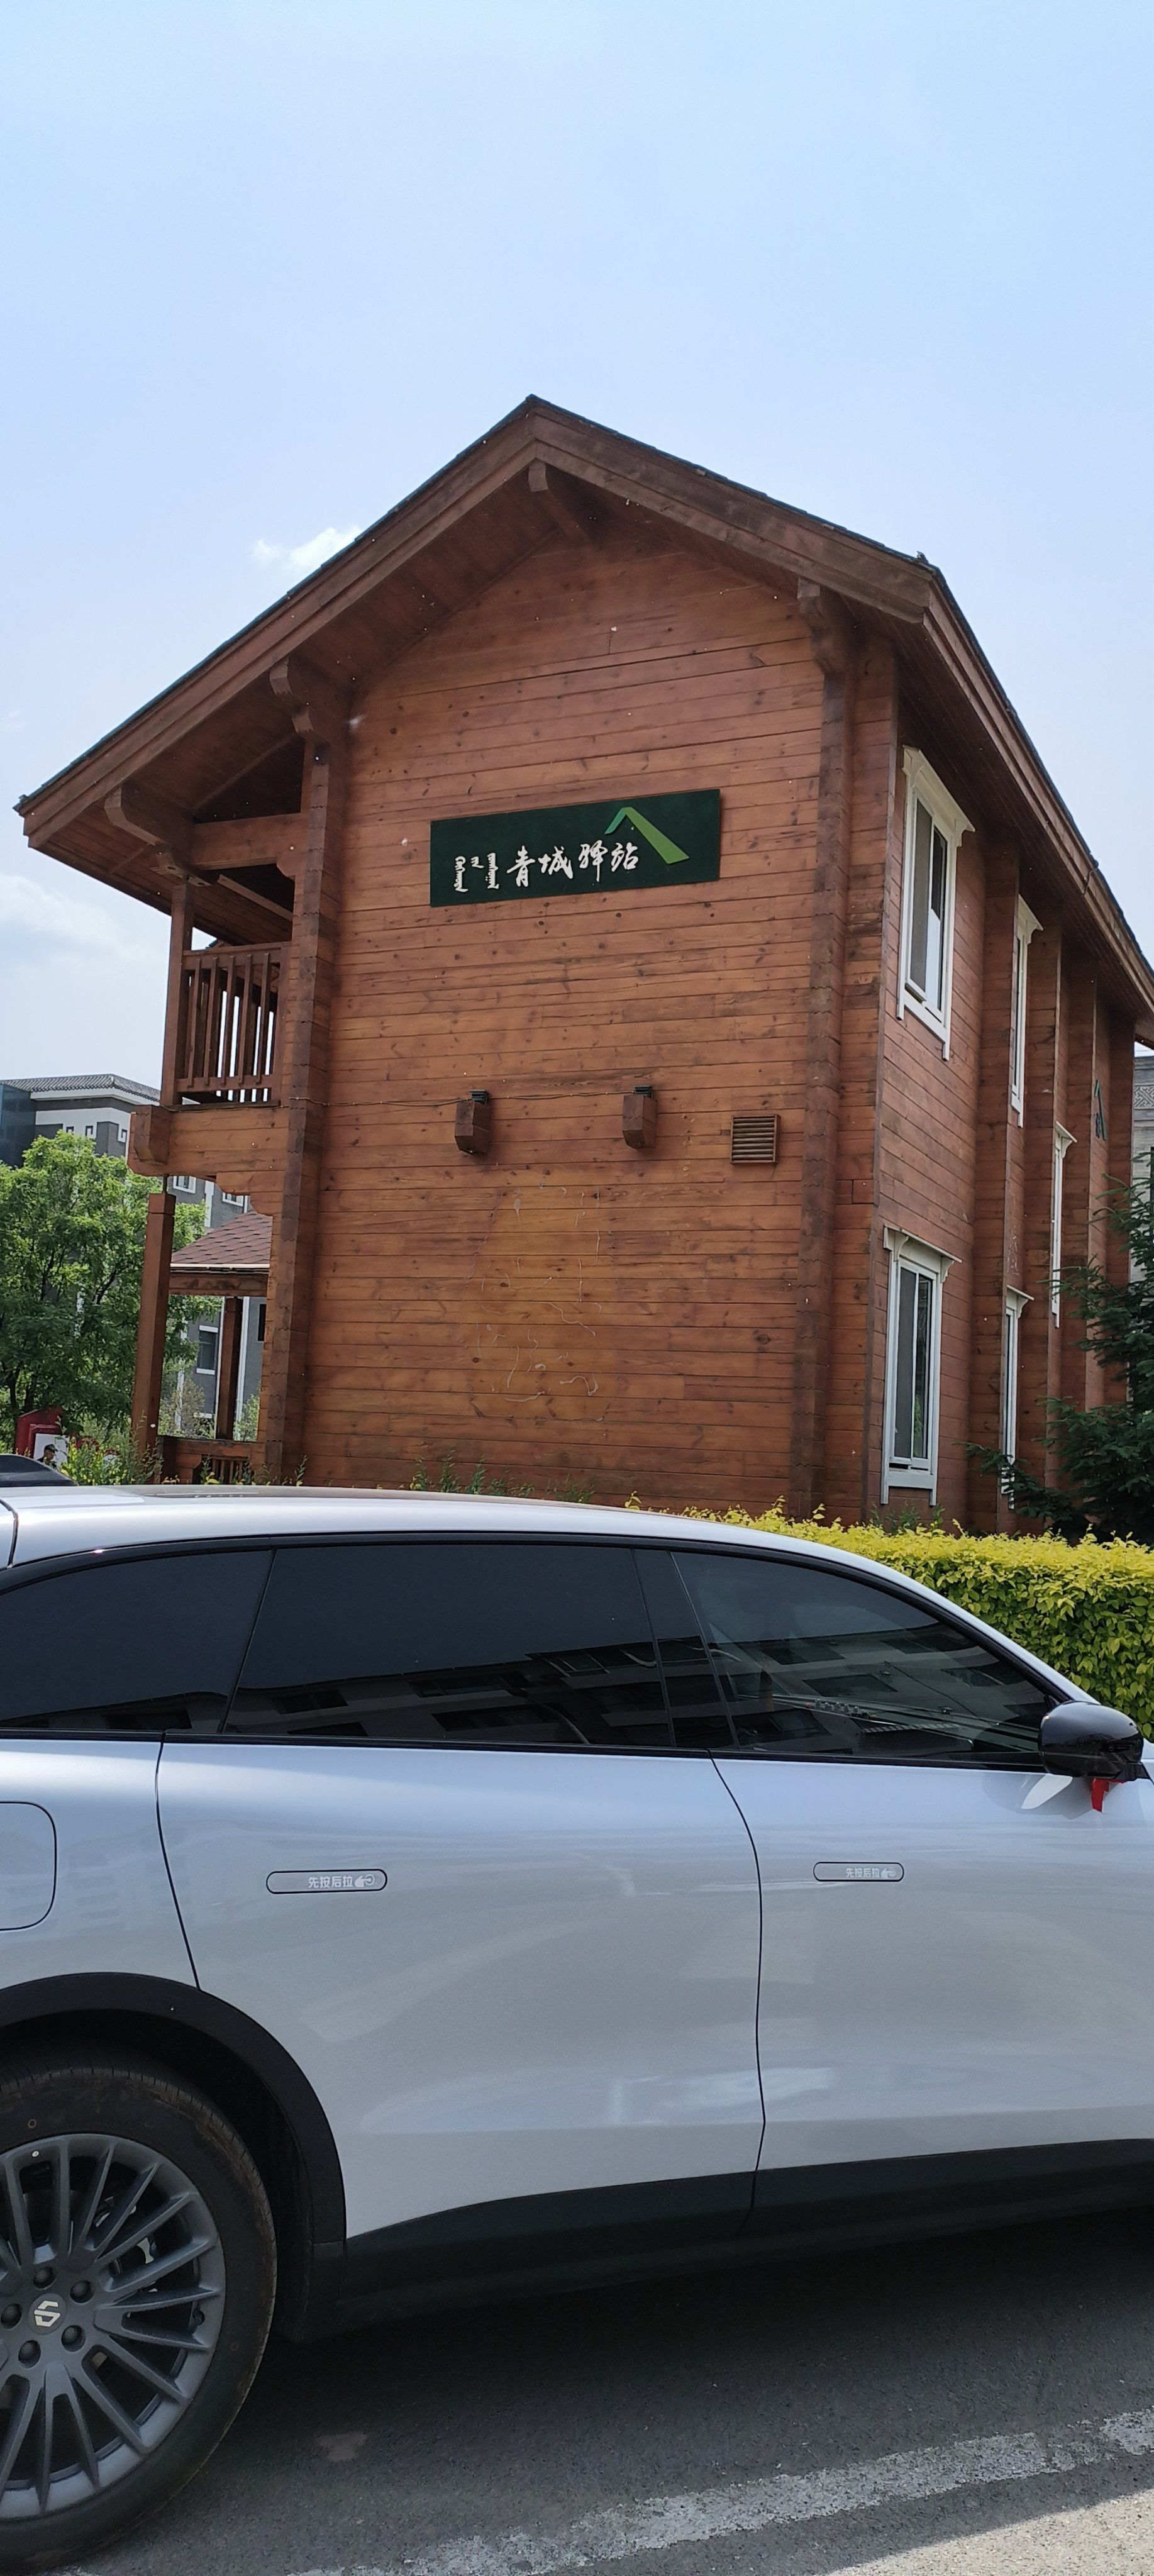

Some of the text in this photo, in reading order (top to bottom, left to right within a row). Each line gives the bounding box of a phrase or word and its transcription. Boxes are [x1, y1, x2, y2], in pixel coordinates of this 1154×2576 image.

[506, 840, 639, 887] 青城驿站
[846, 1867, 880, 1878] 先按后拉
[308, 1875, 353, 1889] 先按后拉
